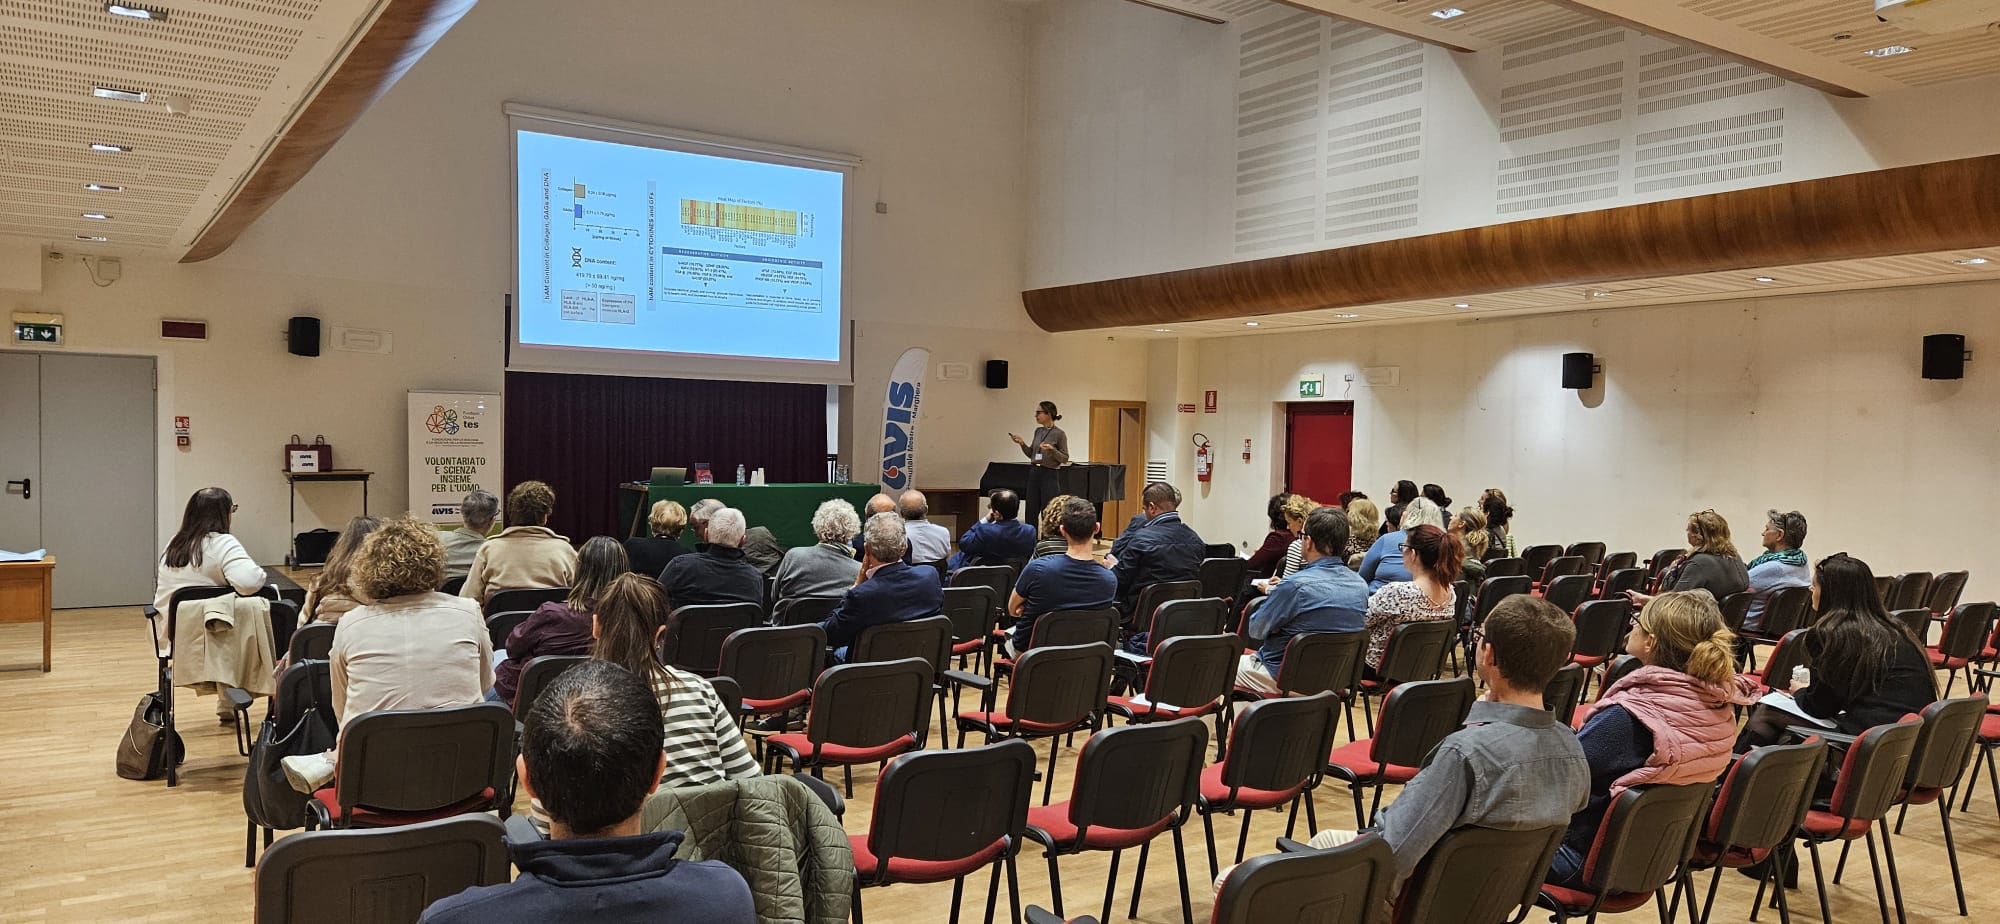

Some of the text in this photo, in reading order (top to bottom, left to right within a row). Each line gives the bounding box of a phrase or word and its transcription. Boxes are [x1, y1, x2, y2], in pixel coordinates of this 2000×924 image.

[912, 382, 920, 418] Marghera
[424, 457, 486, 466] VOLONTARIATO
[435, 466, 476, 474] E SCIENZA
[440, 475, 472, 483] INSIEME
[432, 484, 446, 492] PER
